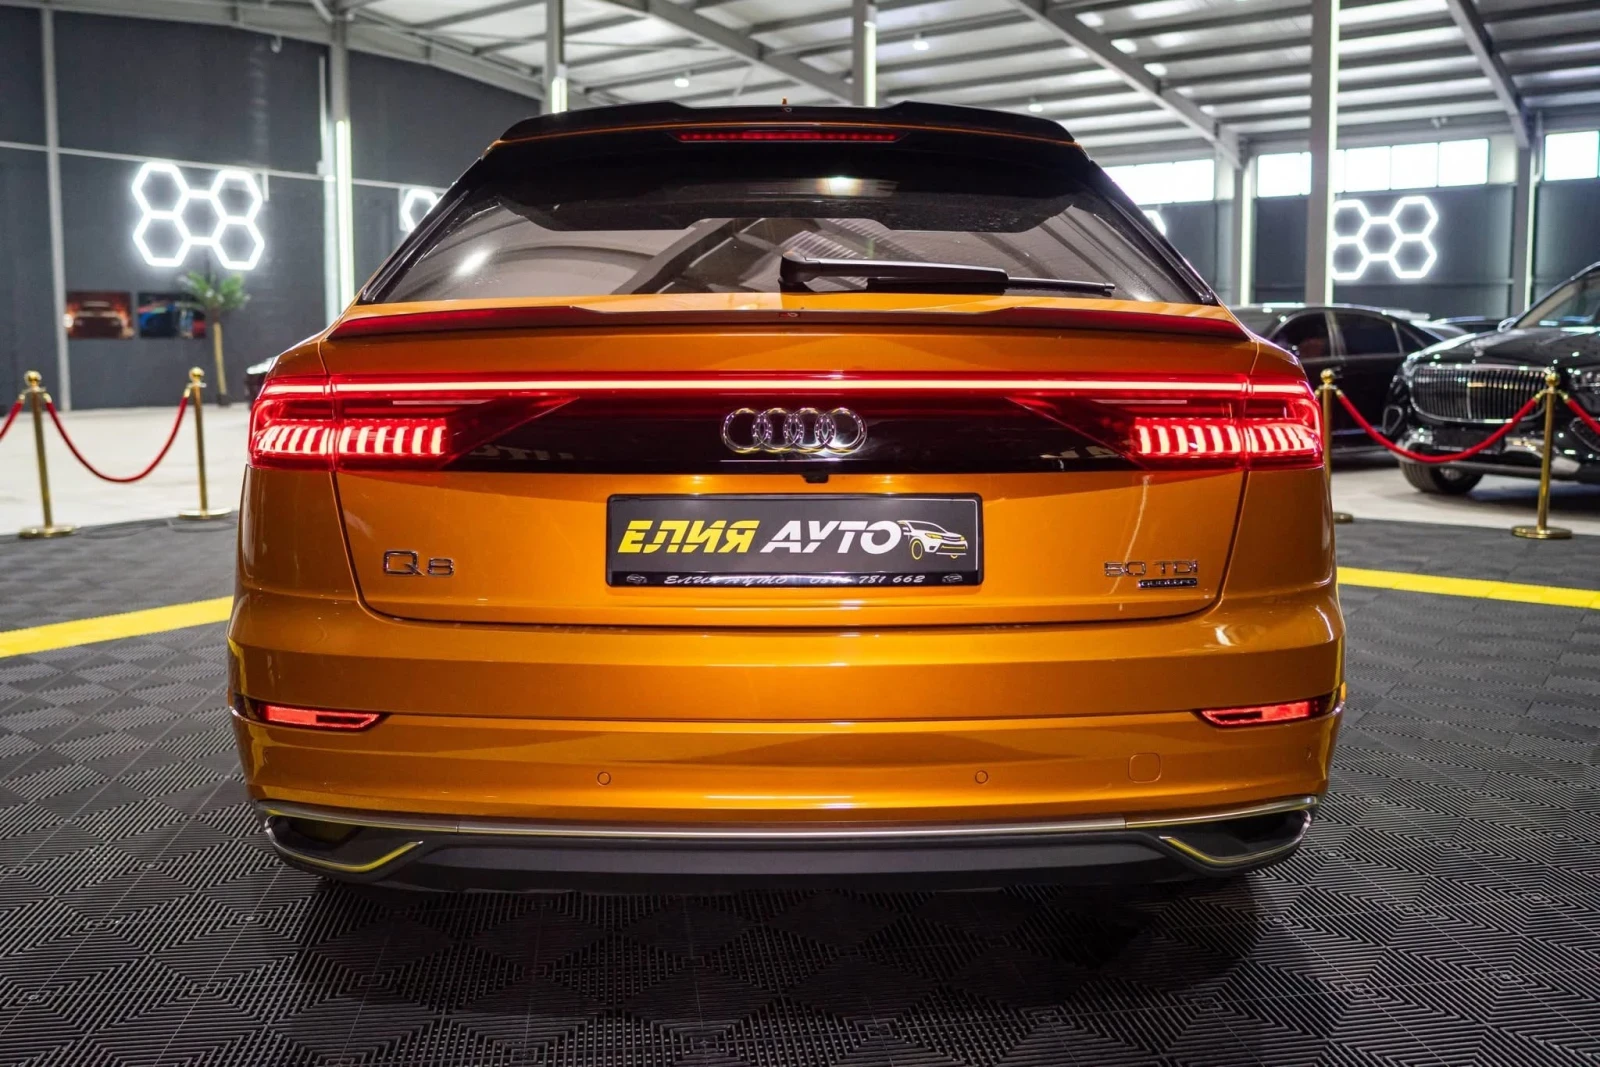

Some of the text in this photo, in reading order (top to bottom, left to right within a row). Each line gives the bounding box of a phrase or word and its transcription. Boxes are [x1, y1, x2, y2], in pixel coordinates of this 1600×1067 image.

[618, 520, 902, 554] ЕЛИЯ АУТО
[383, 550, 455, 576] Q8
[1104, 560, 1197, 577] 50 TDI
[859, 575, 887, 584] 781
[892, 575, 926, 583] 662
